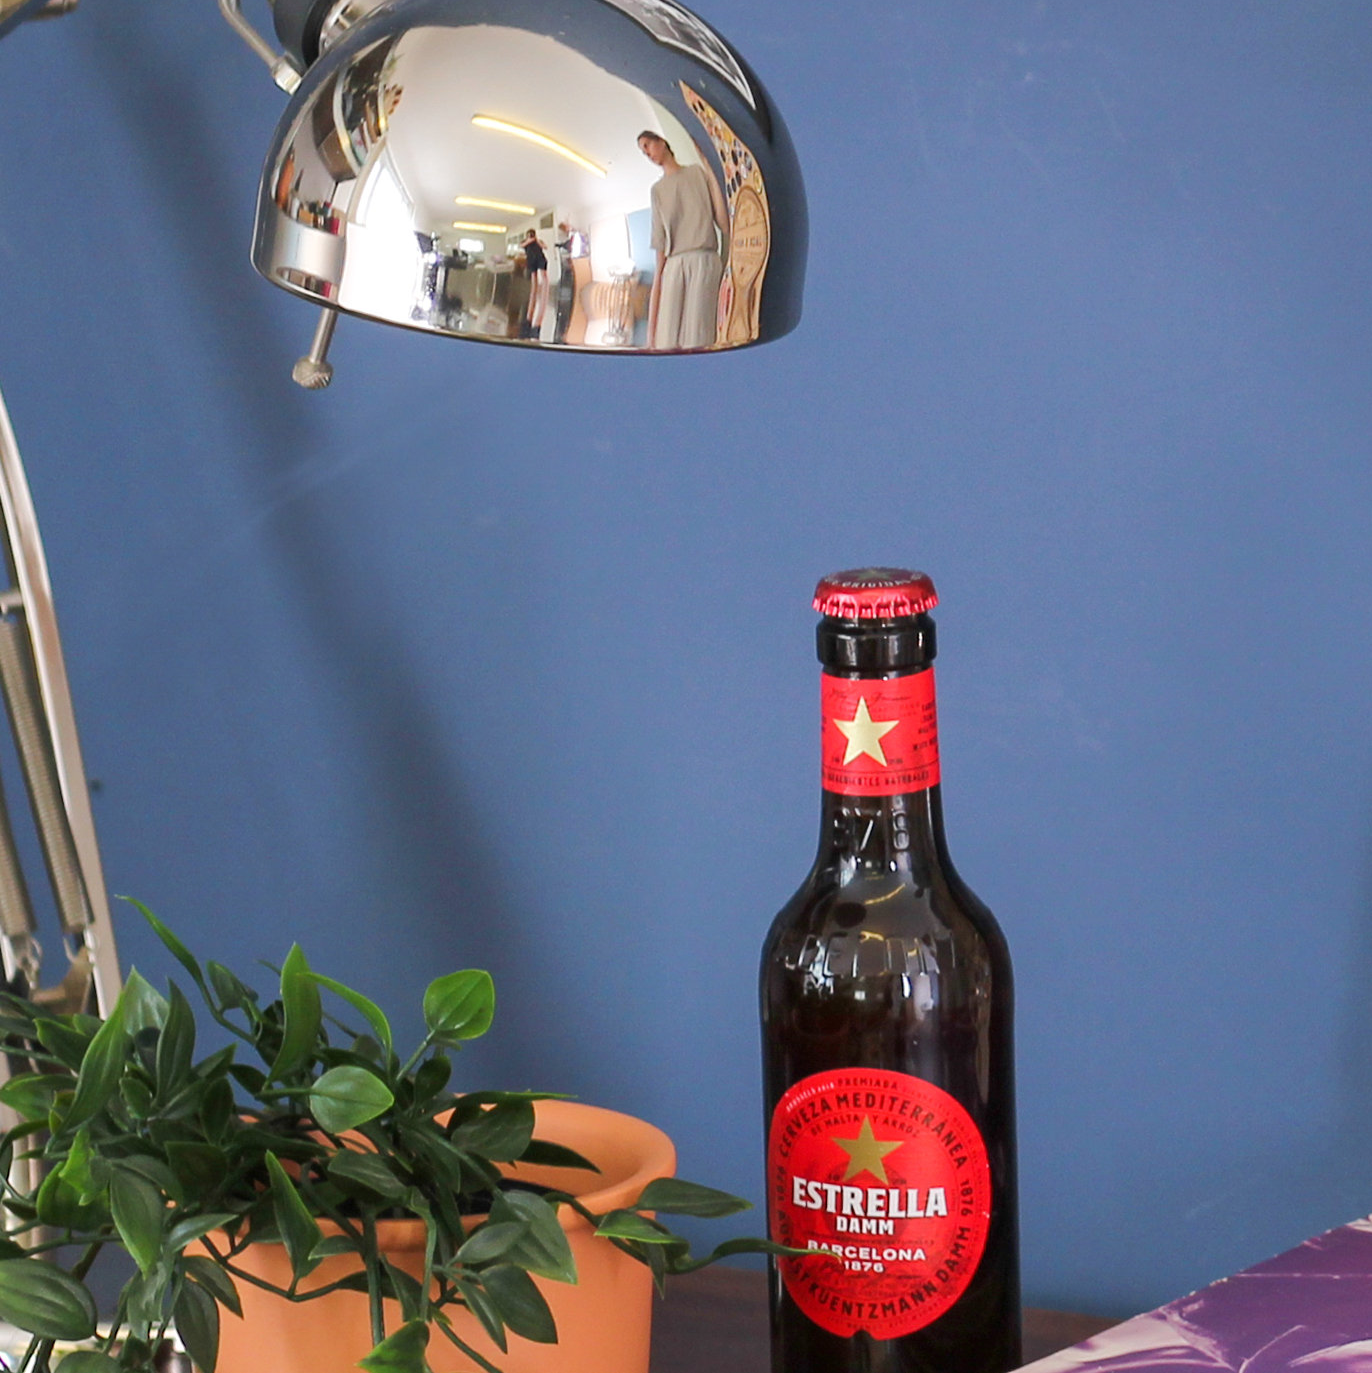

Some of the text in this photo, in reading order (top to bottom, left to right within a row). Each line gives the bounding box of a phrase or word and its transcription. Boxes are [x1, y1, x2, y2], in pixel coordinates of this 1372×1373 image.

[779, 1096, 832, 1158] CERVEZA
[959, 1179, 974, 1216] 1876
[792, 1175, 948, 1219] ESTRELLA
[836, 1215, 895, 1236] DAMM
[844, 1260, 885, 1274] 1876
[935, 1226, 971, 1283] DAMM
